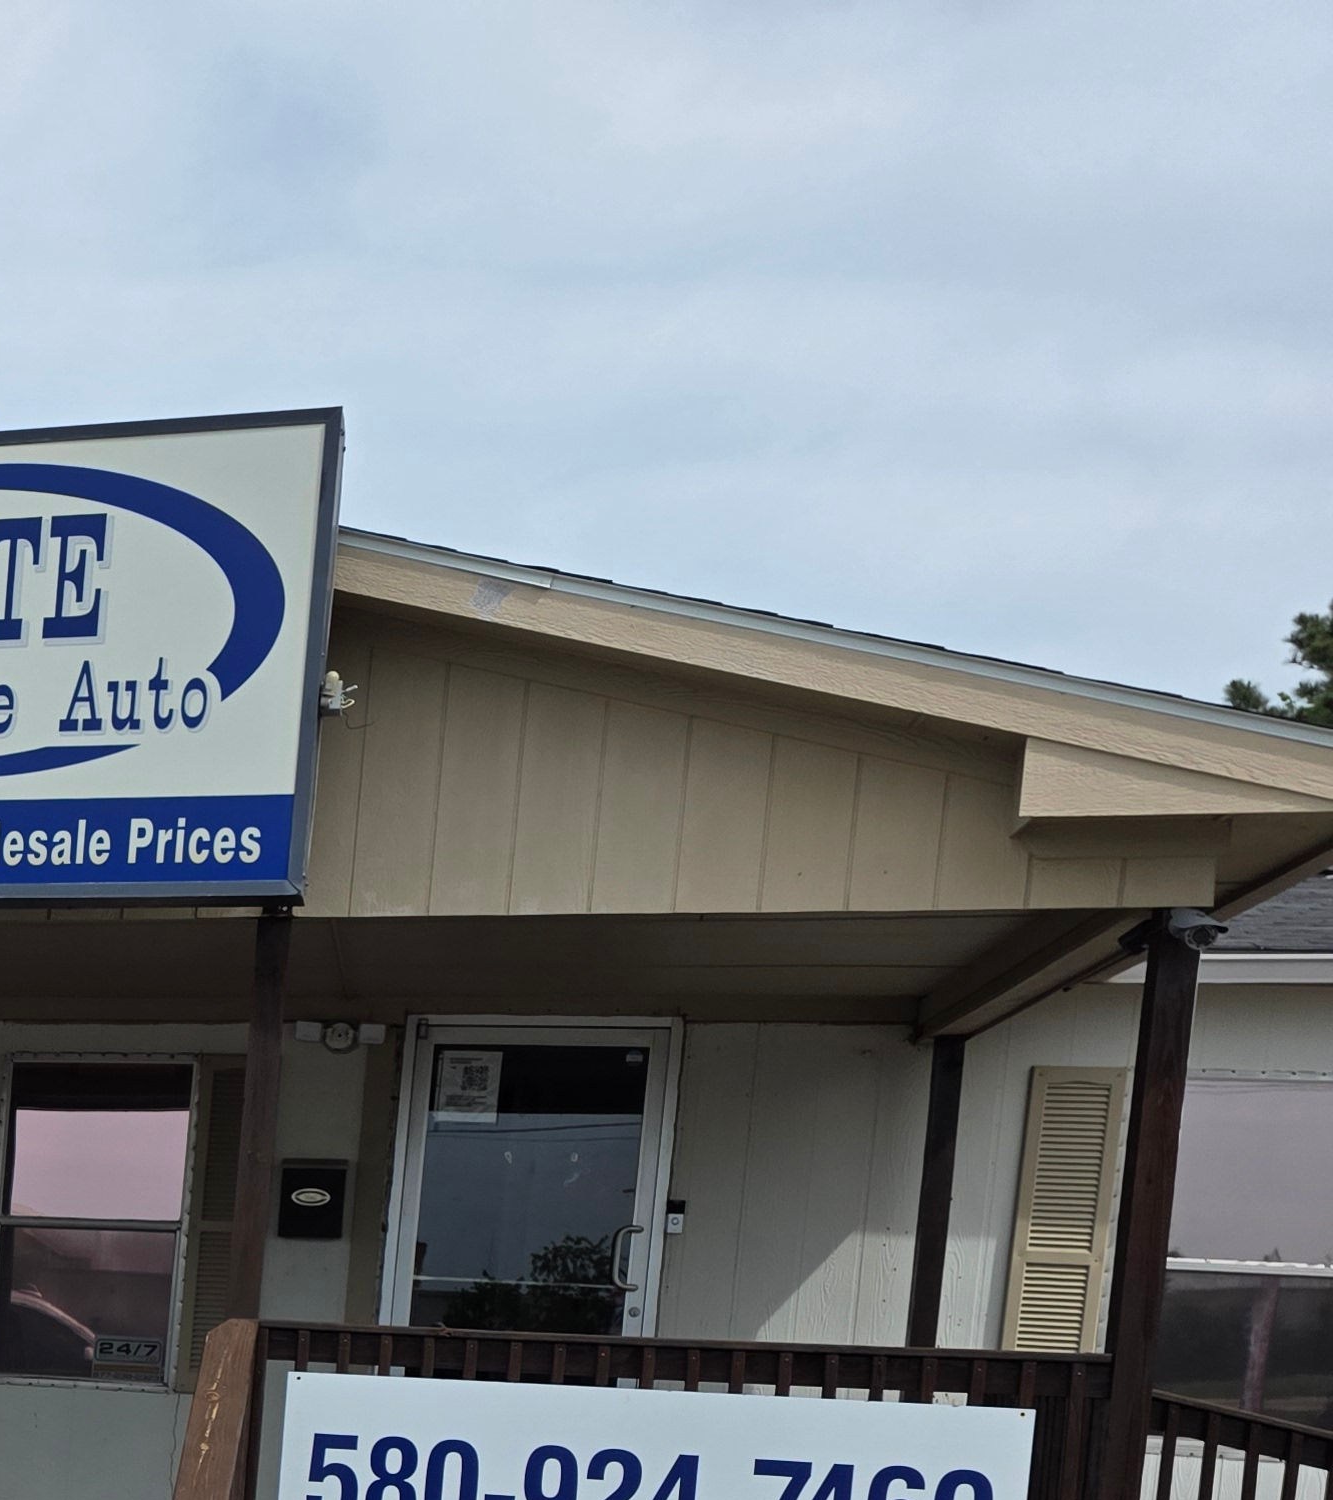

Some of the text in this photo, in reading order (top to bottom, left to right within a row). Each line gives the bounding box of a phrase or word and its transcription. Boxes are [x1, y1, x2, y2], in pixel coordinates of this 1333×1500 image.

[59, 657, 211, 732] Auto
[127, 816, 262, 865] Prices
[99, 1342, 158, 1357] 24/7
